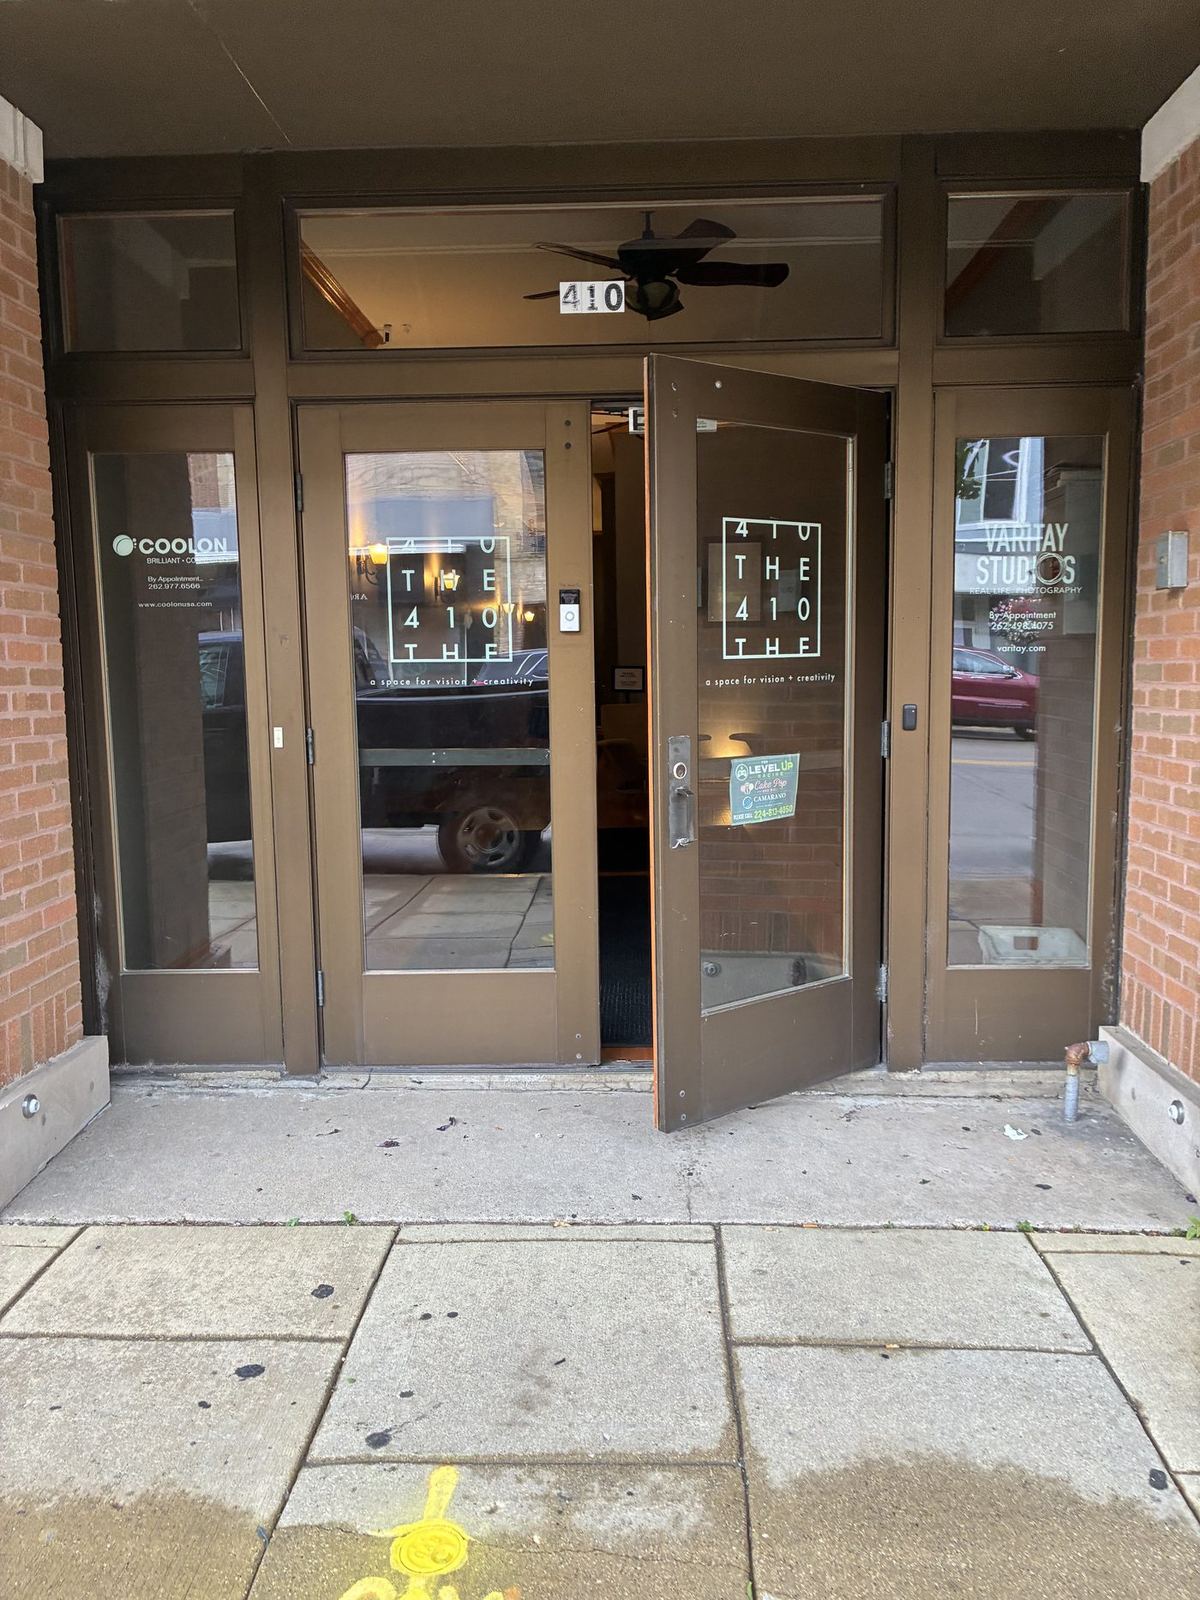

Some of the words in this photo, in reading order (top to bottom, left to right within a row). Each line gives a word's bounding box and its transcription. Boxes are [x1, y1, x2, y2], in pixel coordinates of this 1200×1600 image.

[562, 283, 624, 311] 410
[985, 523, 1069, 552] VARITAY
[138, 538, 228, 554] COOLON
[976, 553, 1076, 585] STUDIOS
[1015, 586, 1083, 595] PHOTOGRAPHY
[989, 611, 1000, 620] By
[1003, 611, 1057, 620] Appointment
[997, 645, 1047, 654] varitay.com
[381, 679, 411, 688] space
[416, 677, 431, 685] for
[435, 677, 467, 685] vision
[483, 677, 534, 687] creativity
[715, 678, 740, 688] space
[743, 675, 756, 684] for
[760, 675, 785, 684] vision
[797, 673, 836, 683] creativity
[749, 763, 780, 774] LEVEL
[781, 760, 793, 770] UP
[755, 780, 772, 790] Cake
